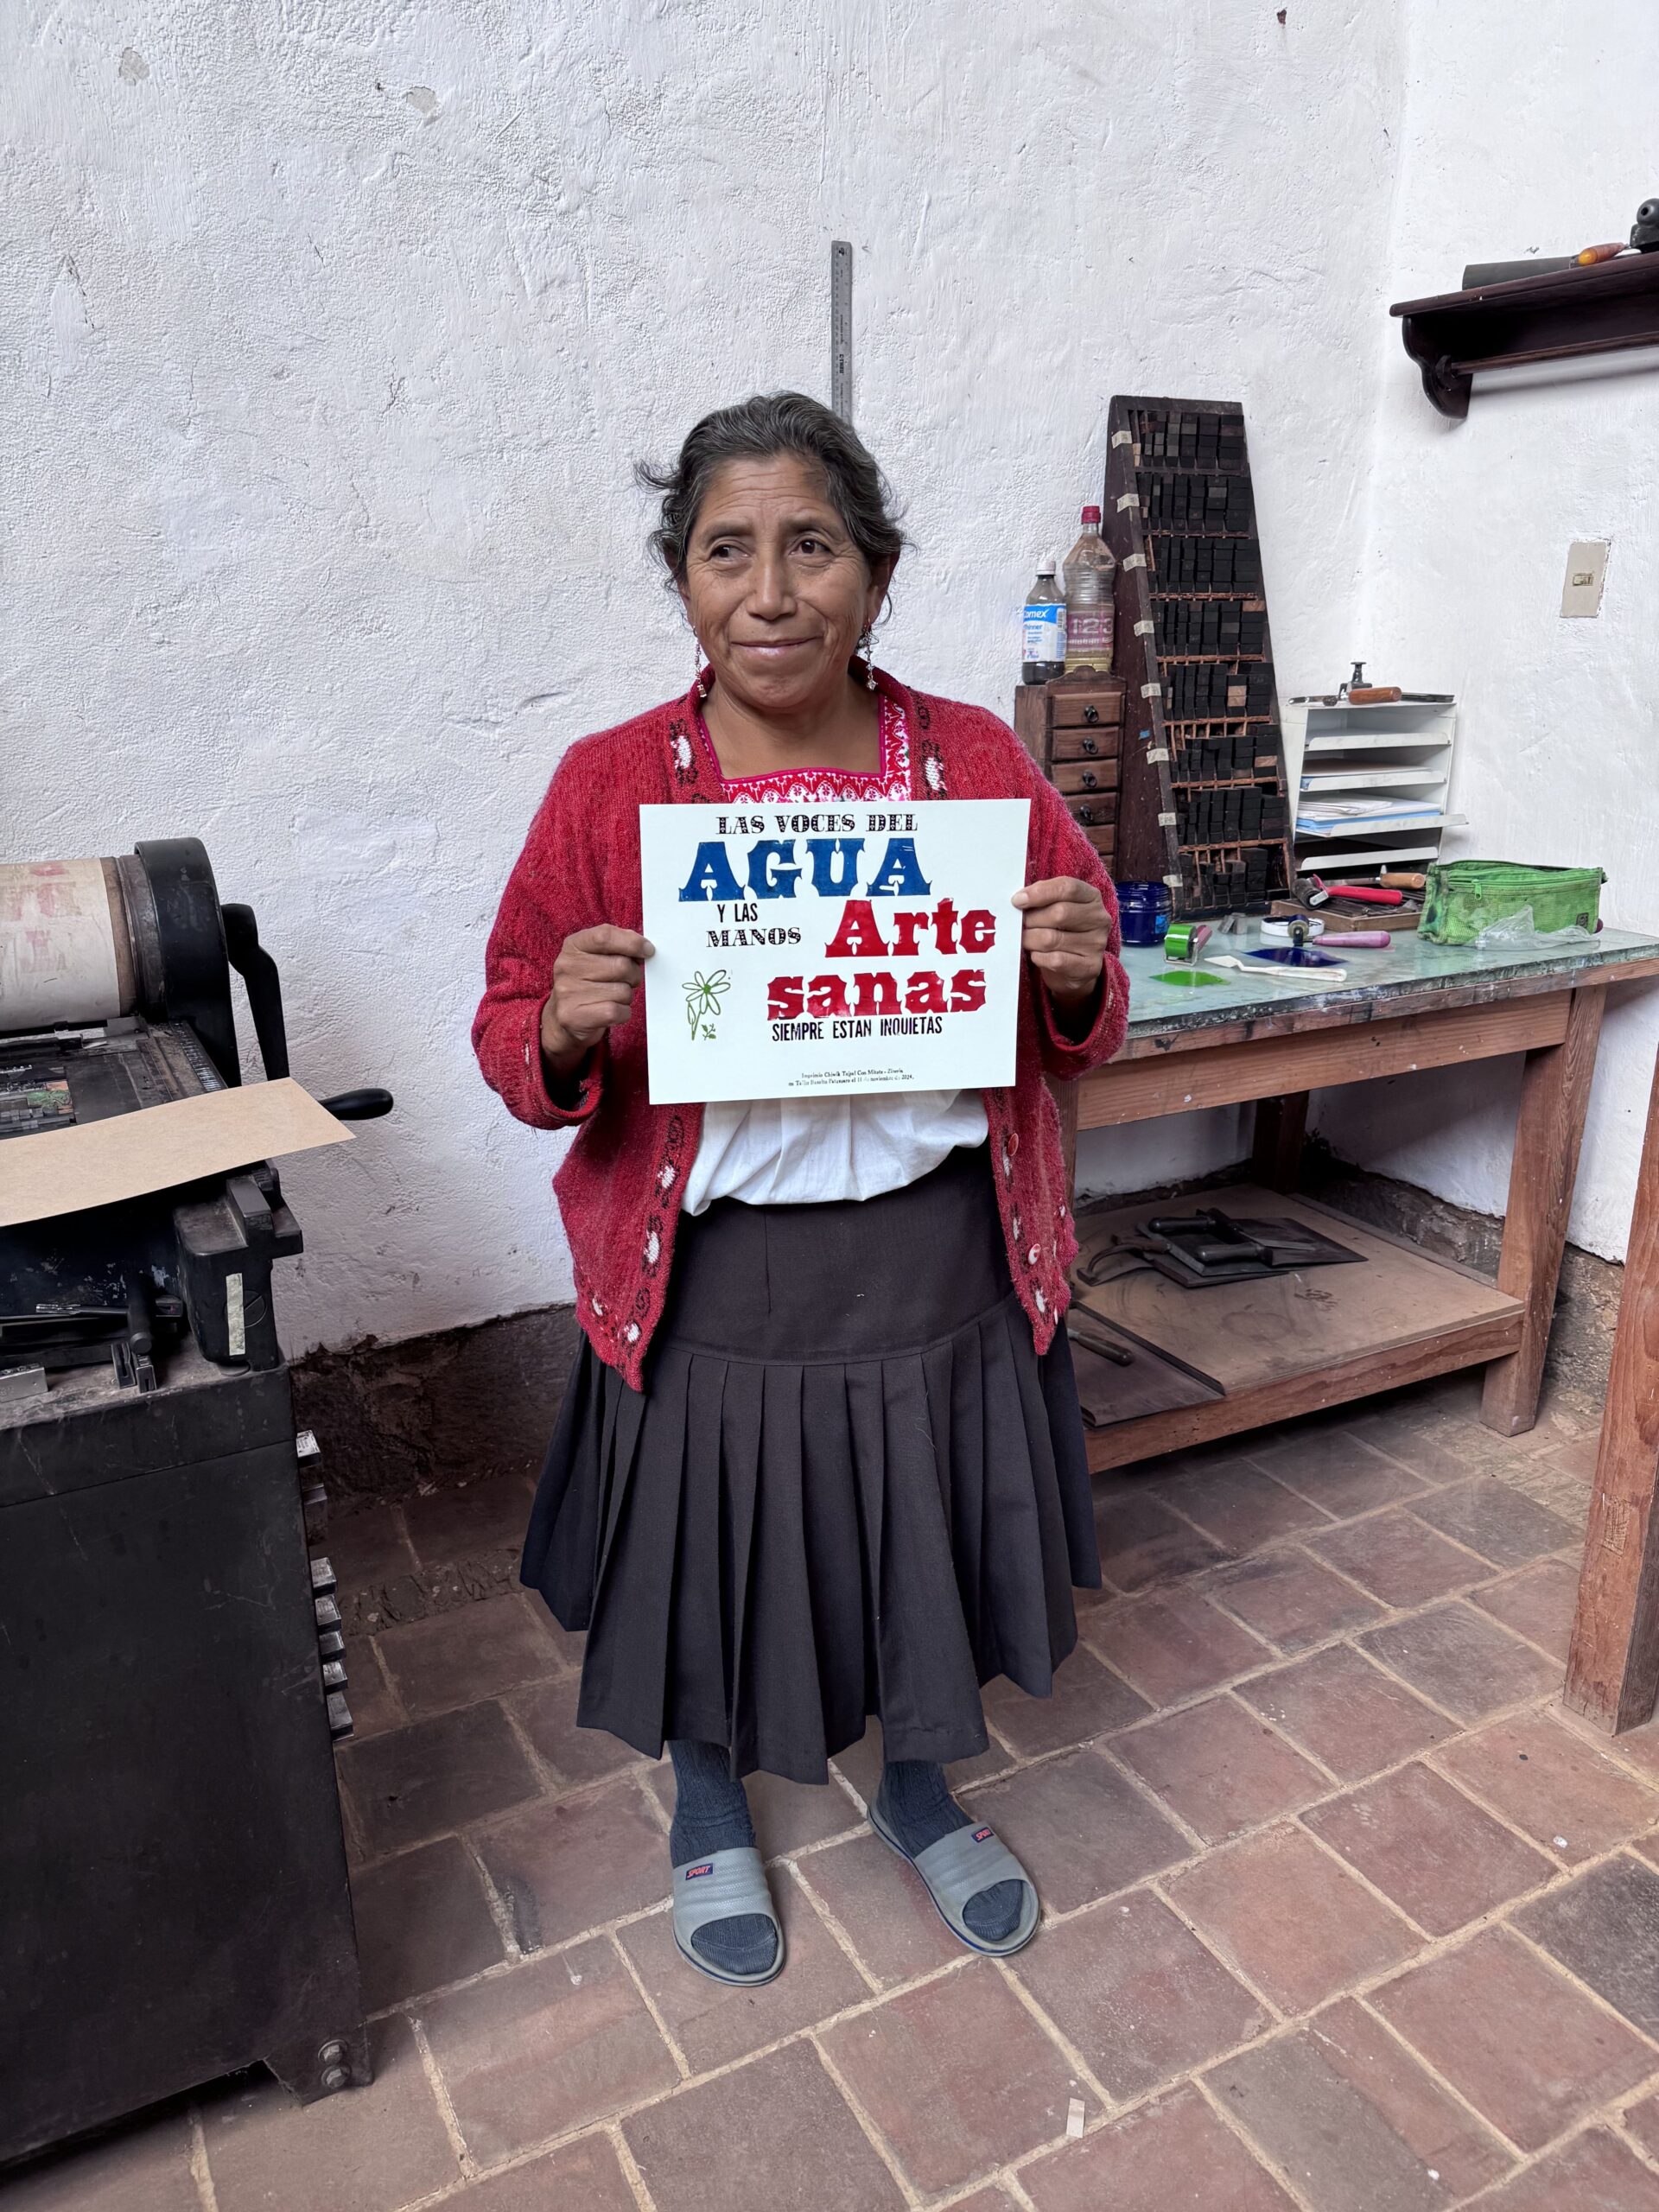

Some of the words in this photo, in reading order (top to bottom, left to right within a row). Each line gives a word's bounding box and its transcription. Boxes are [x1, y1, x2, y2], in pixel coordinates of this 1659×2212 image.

[715, 816, 766, 835] LAS
[774, 814, 855, 833] VOCES
[865, 814, 918, 832] DEL
[678, 837, 933, 902] AGUA
[716, 904, 726, 923] Y
[734, 903, 759, 922] LAS
[706, 927, 802, 948] MANOS
[824, 898, 997, 957] Arte
[766, 969, 987, 1021] sanas
[772, 1021, 824, 1042] SIEMPRE
[832, 1020, 873, 1039] ESTAN
[880, 1016, 944, 1037] INQUIETAS
[687, 1865, 711, 1878] SPORT
